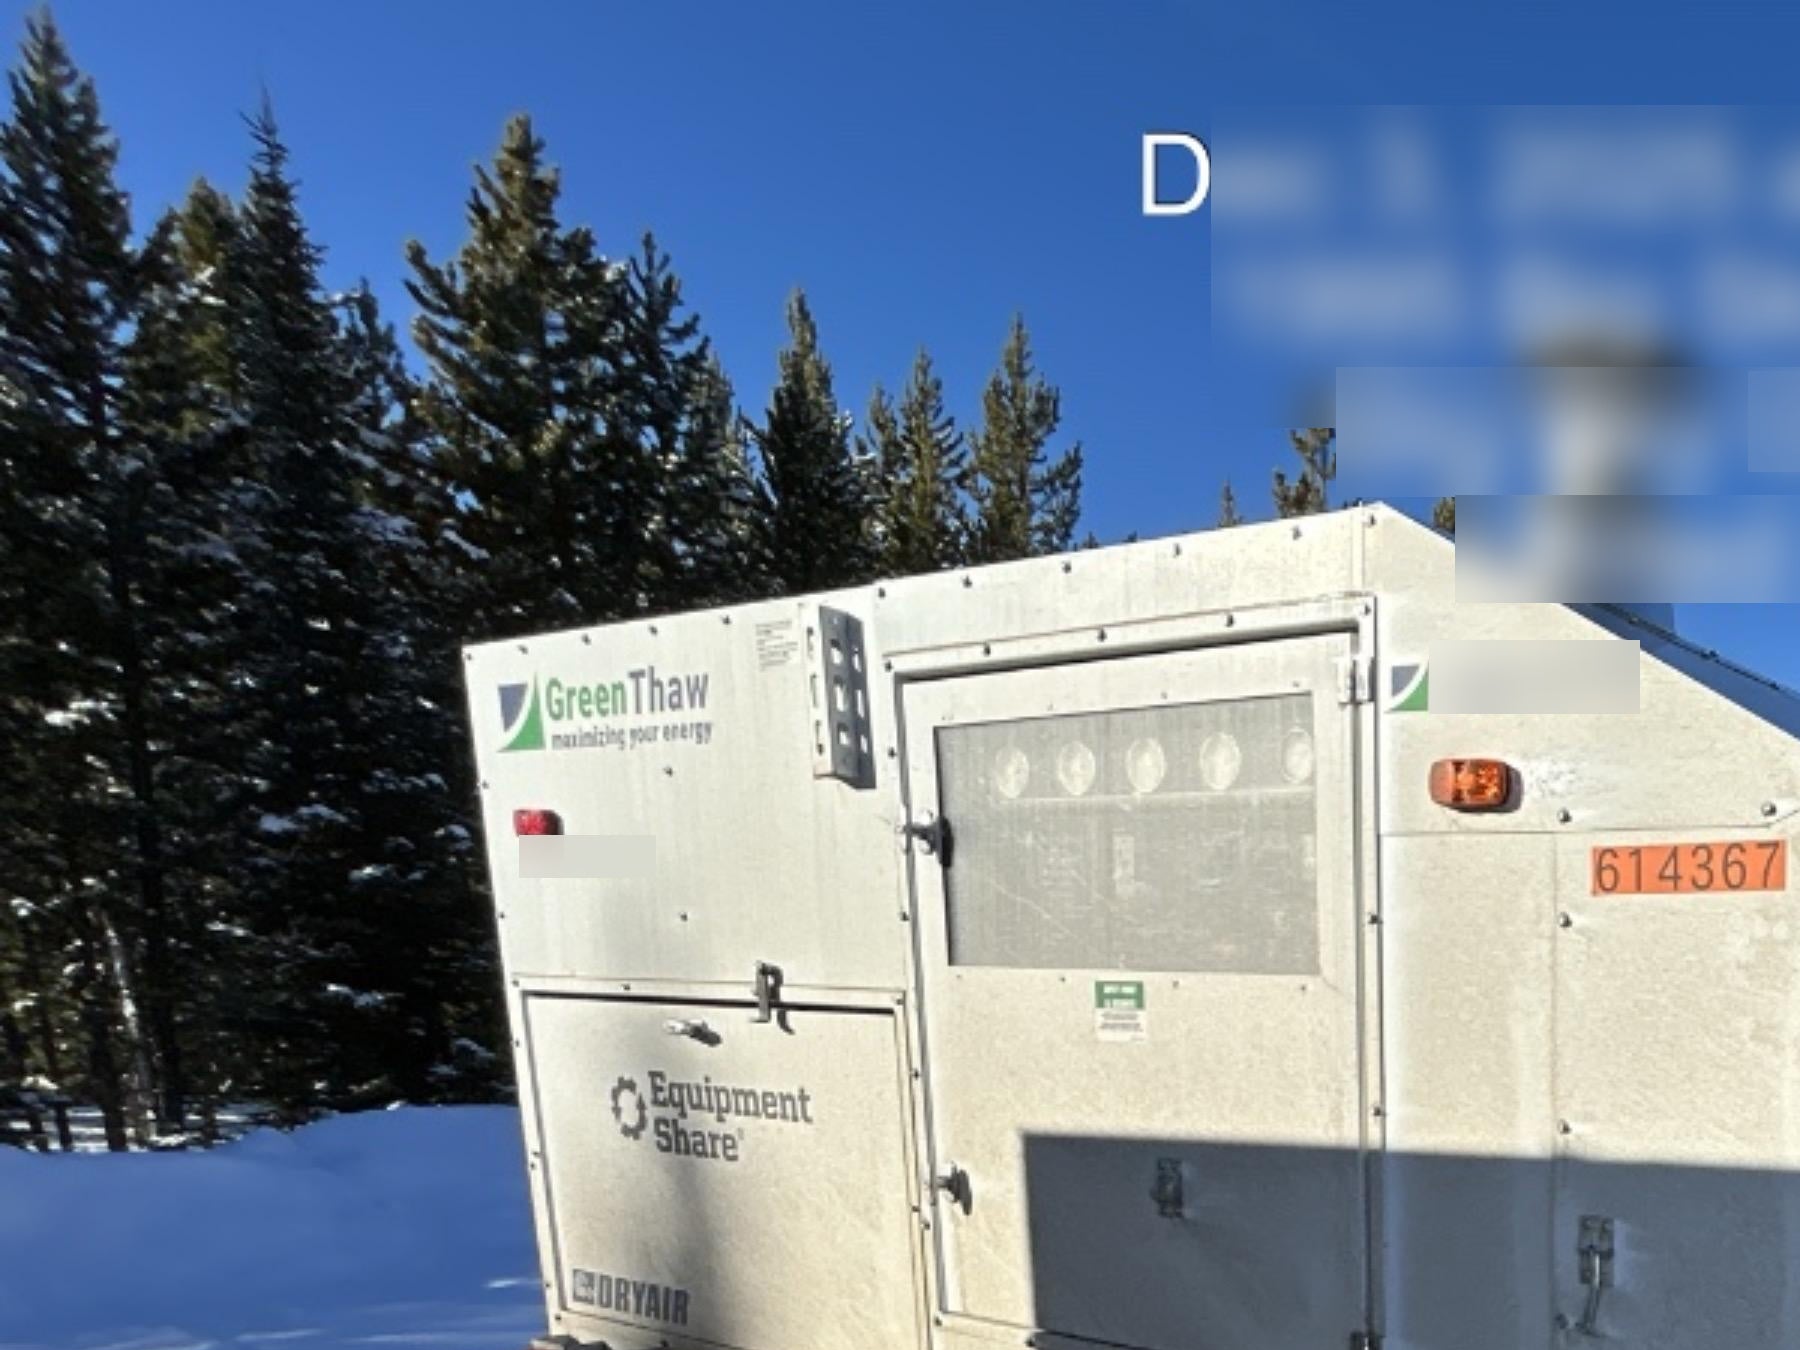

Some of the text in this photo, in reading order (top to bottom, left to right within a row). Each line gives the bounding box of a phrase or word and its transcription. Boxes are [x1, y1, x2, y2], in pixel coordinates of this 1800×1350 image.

[545, 665, 709, 721] GreenThaw
[551, 721, 712, 750] maximizing your energy
[1596, 841, 1780, 892] 614367
[648, 1070, 813, 1124] Equipment
[654, 1115, 740, 1162] Share
[598, 1274, 689, 1325] DRYAIR
